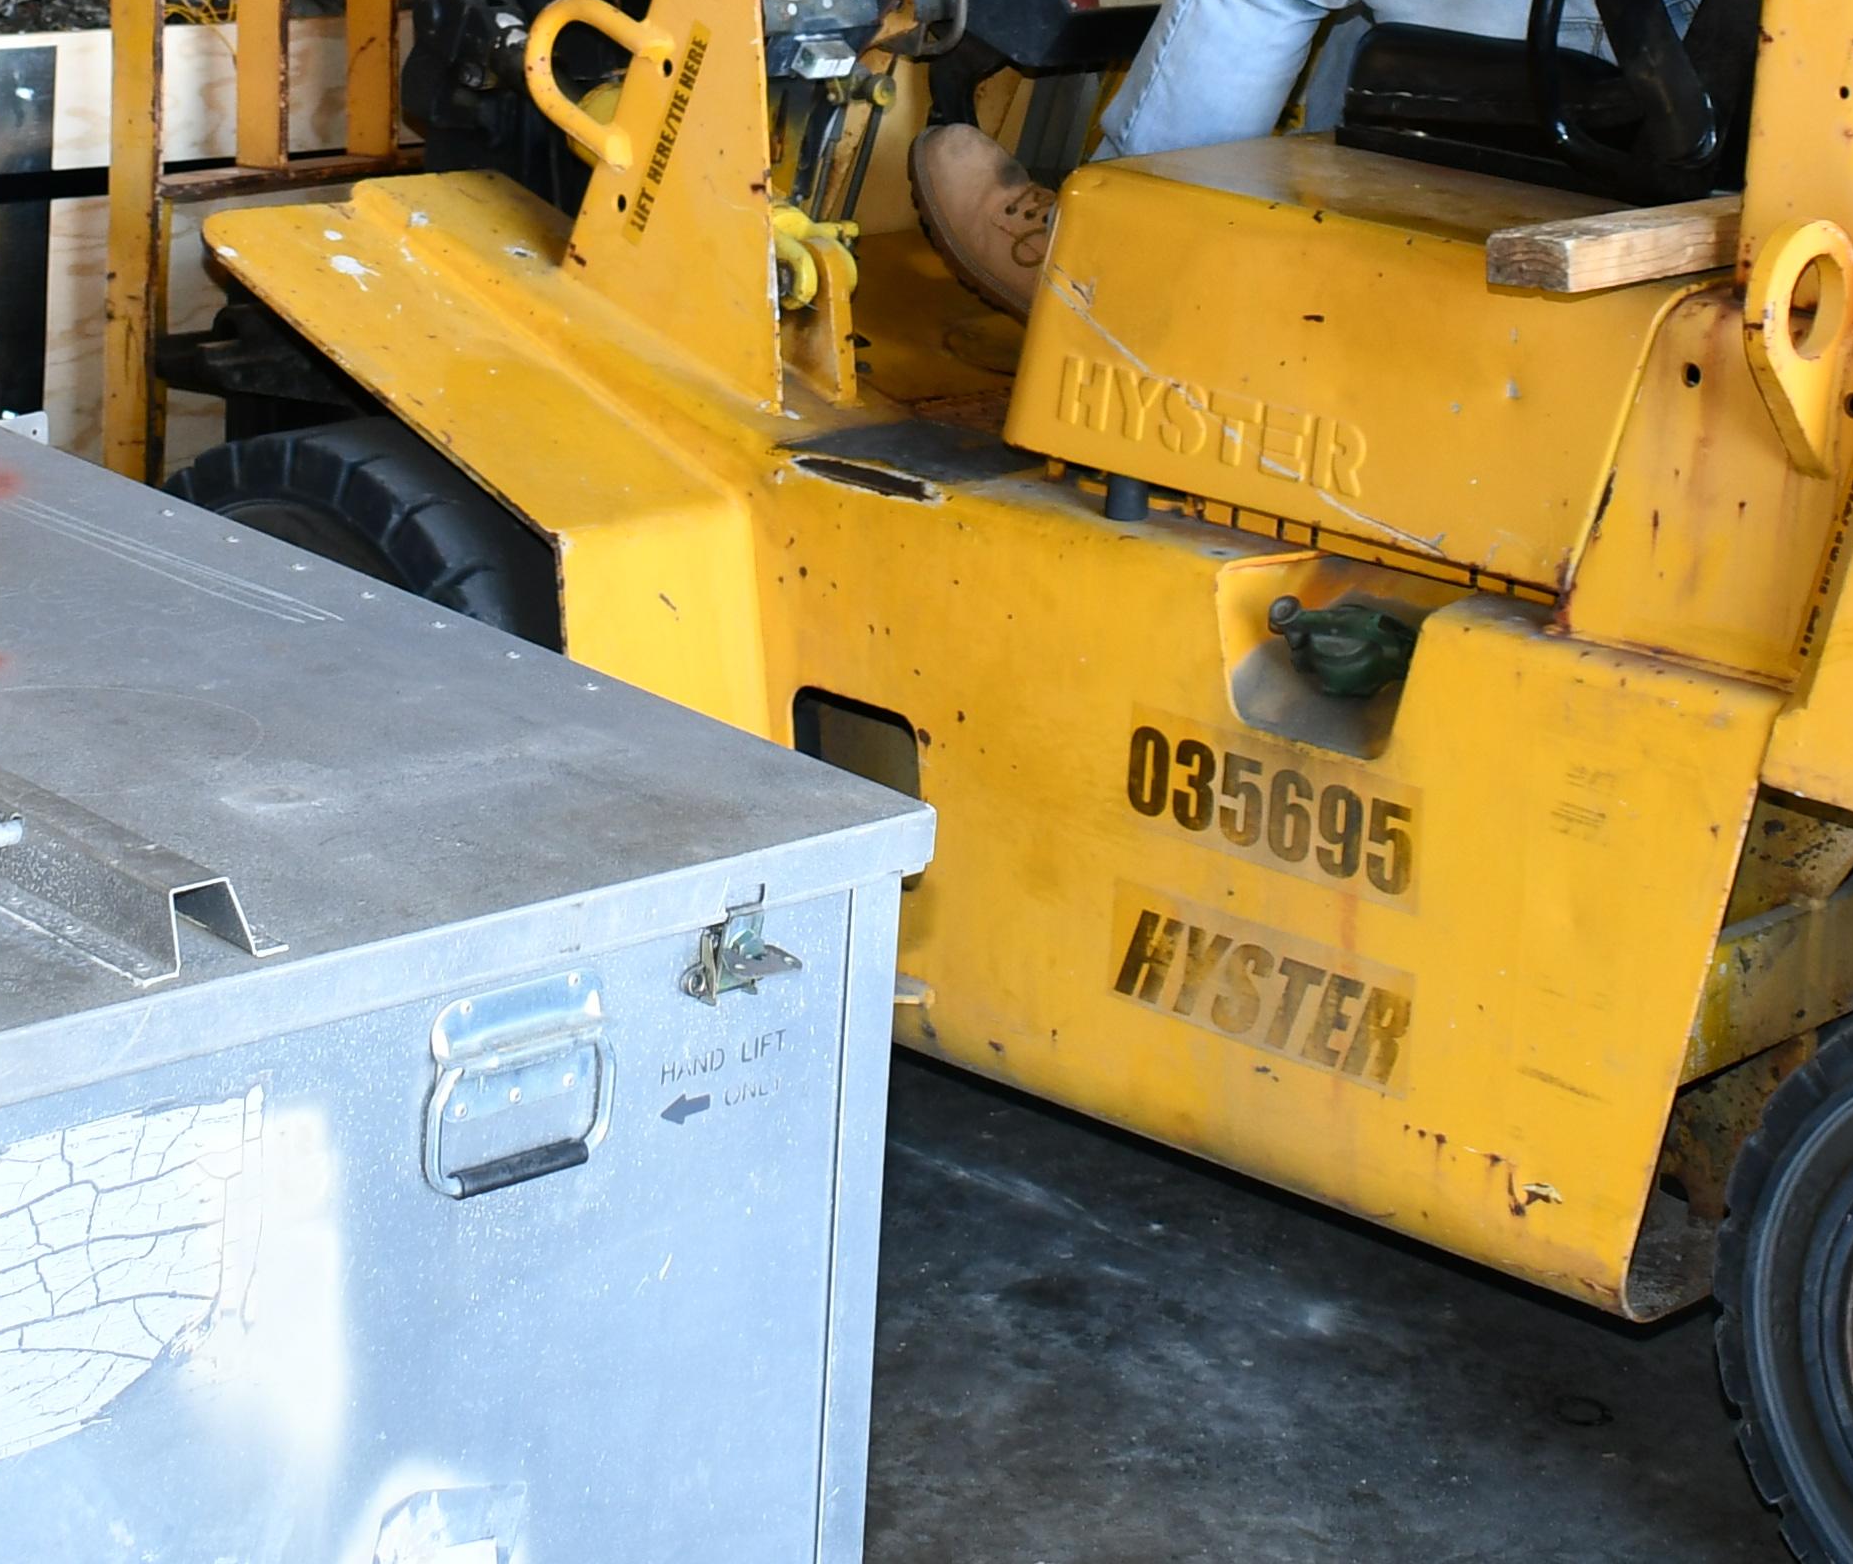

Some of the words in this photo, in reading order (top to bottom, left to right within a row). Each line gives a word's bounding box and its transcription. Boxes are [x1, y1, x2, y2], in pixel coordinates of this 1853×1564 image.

[630, 187, 655, 233] LIFT
[678, 36, 708, 92] HERE
[1057, 354, 1367, 498] HYSTER
[1127, 724, 1414, 896] 035695
[660, 1047, 726, 1087] HAND
[741, 1028, 787, 1064] LIFT
[1114, 908, 1412, 1086] HYSTER
